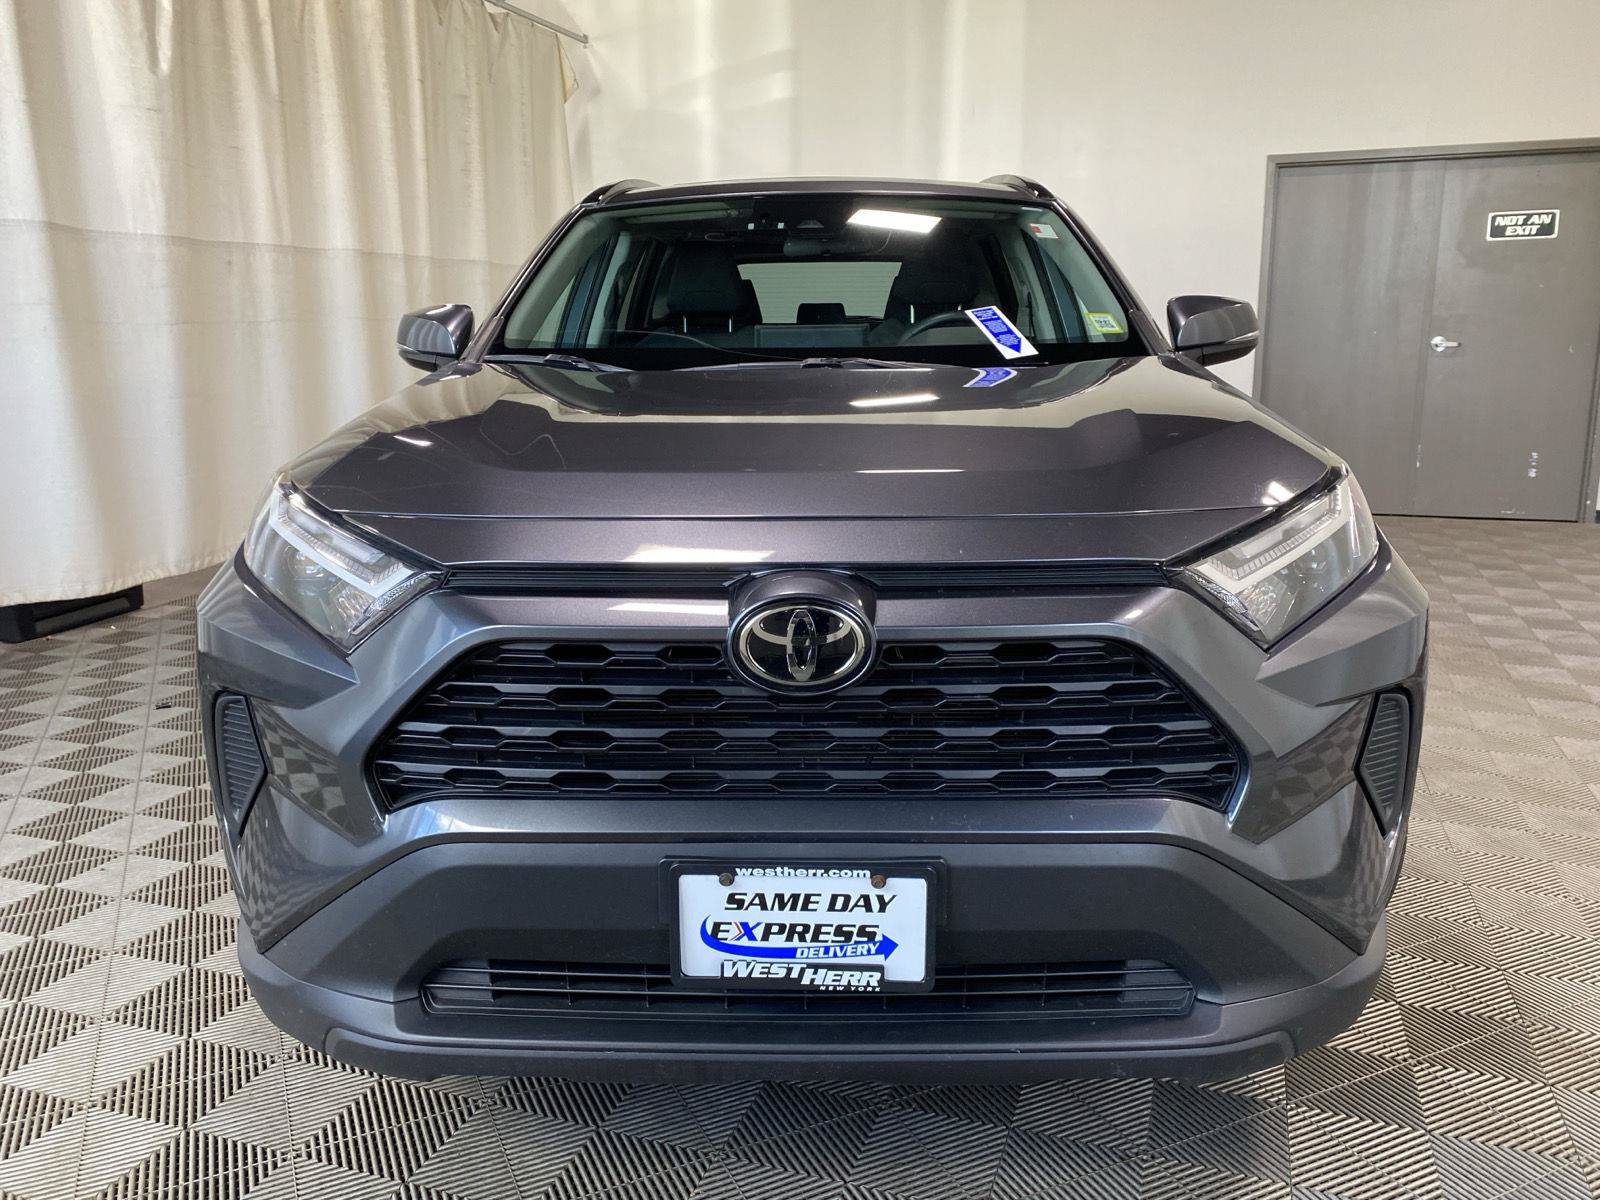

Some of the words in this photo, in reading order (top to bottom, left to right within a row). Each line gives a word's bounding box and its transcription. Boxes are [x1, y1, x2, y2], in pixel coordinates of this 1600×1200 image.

[1495, 215, 1527, 226] NOT
[1527, 214, 1553, 225] AN
[1505, 225, 1540, 236] EXIT
[735, 866, 871, 879] westherr.com
[724, 892, 822, 912] SAME
[826, 894, 897, 913] DAY
[710, 921, 880, 943] EXPRESS
[795, 943, 880, 959] DELIVERY
